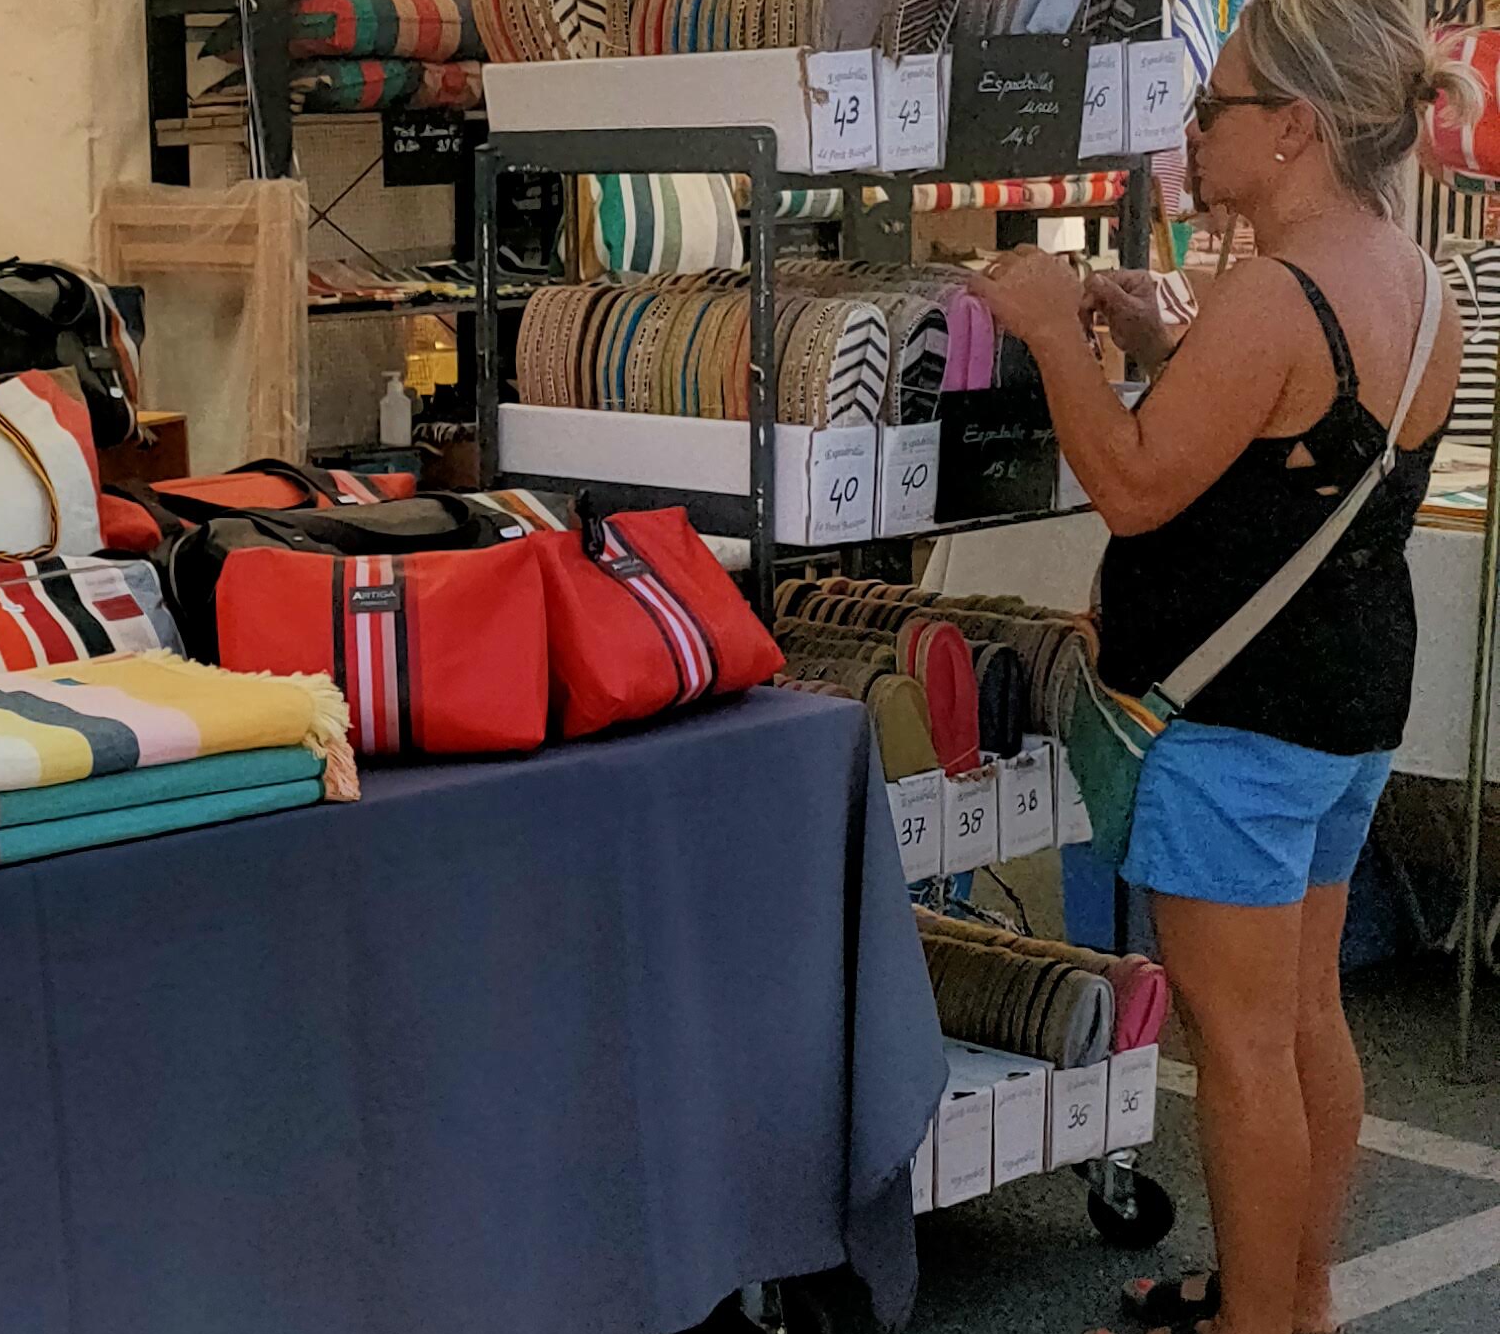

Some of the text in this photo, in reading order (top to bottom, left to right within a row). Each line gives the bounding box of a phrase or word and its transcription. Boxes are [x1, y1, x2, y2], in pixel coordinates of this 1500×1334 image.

[1083, 85, 1110, 116] 46
[1146, 80, 1170, 114] 47
[833, 95, 860, 138] 43
[898, 99, 921, 132] 43
[901, 463, 928, 496] 40
[829, 476, 859, 517] 40
[1017, 788, 1038, 816] 38
[901, 817, 926, 846] 37
[958, 808, 985, 837] 38
[1067, 1103, 1092, 1130] 36
